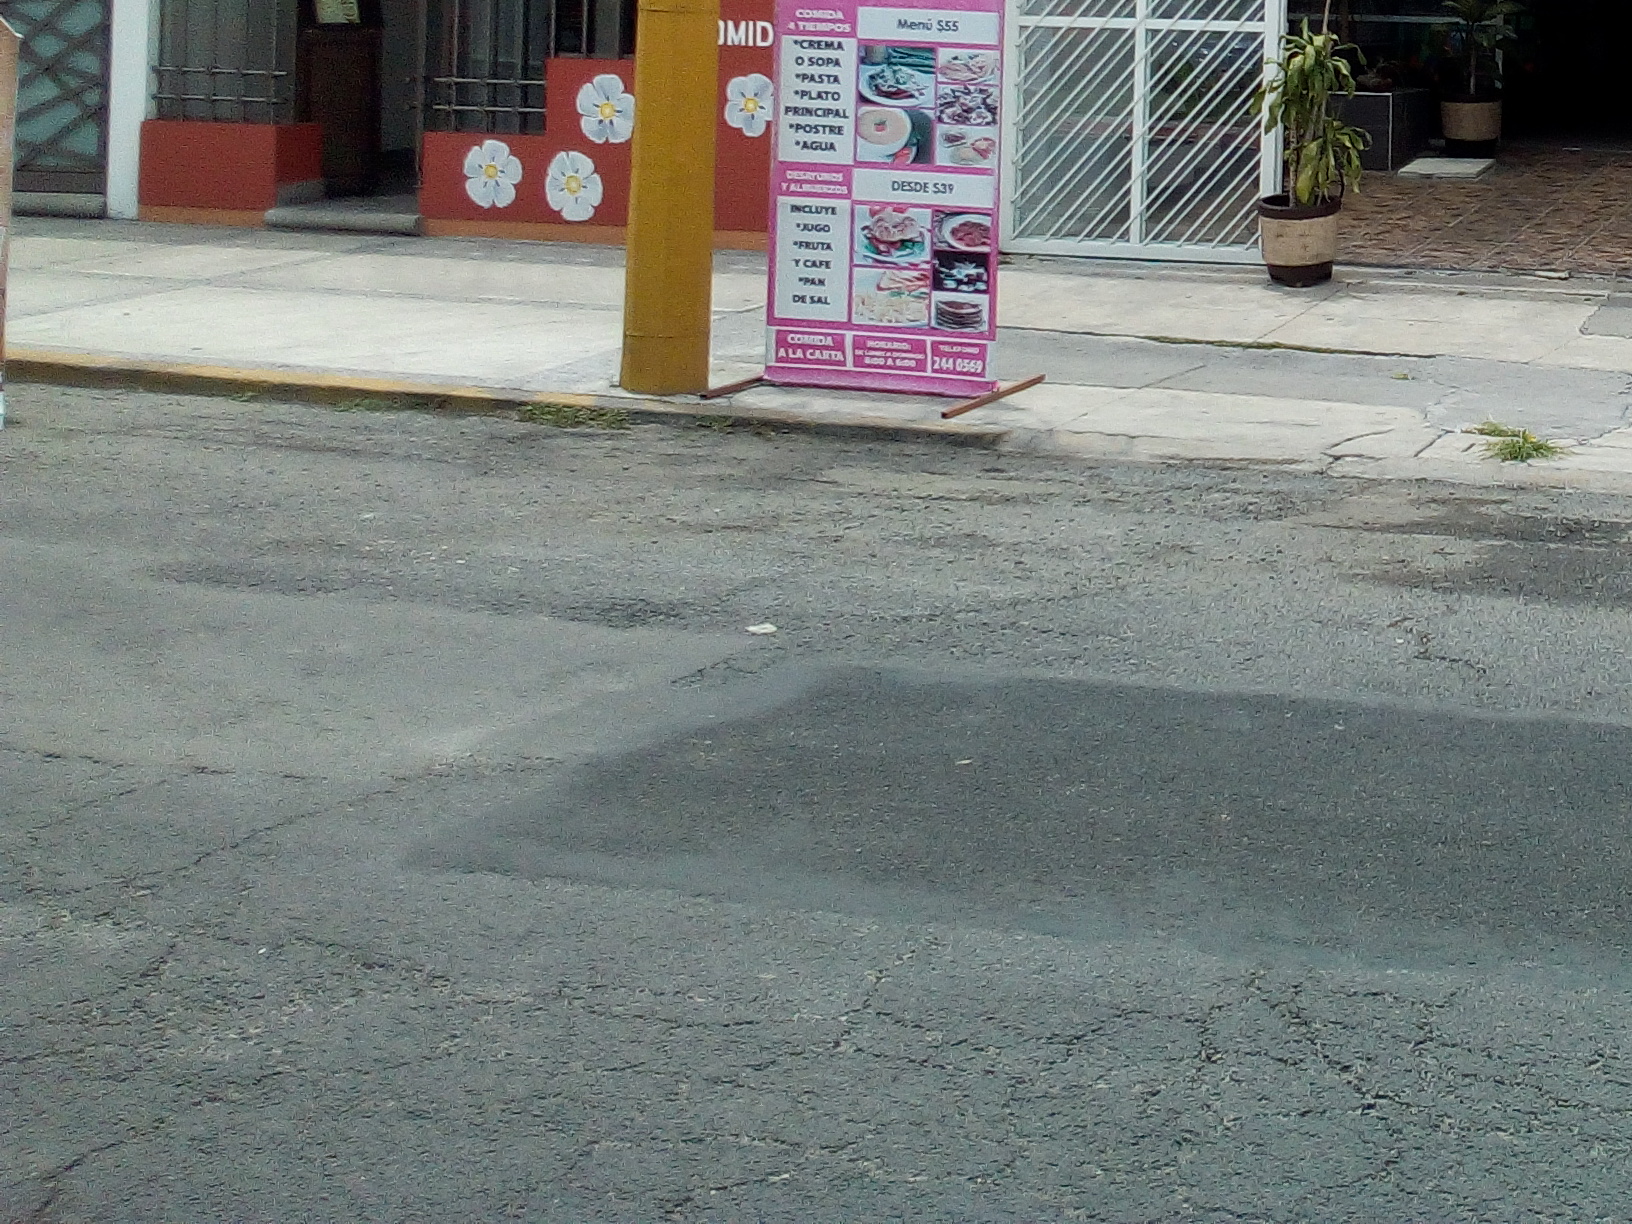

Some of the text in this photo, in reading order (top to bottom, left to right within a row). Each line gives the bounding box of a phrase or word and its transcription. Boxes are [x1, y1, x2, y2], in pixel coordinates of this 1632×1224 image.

[897, 18, 959, 34] Menú $55
[795, 56, 842, 68] O SOPA
[784, 106, 849, 119] PRINCIPAL
[891, 180, 929, 193] DESDE
[790, 204, 837, 215] INCLUYE
[792, 258, 801, 267] Y
[792, 294, 831, 305] DE SAL
[778, 347, 787, 358] A
[789, 348, 804, 359] LA
